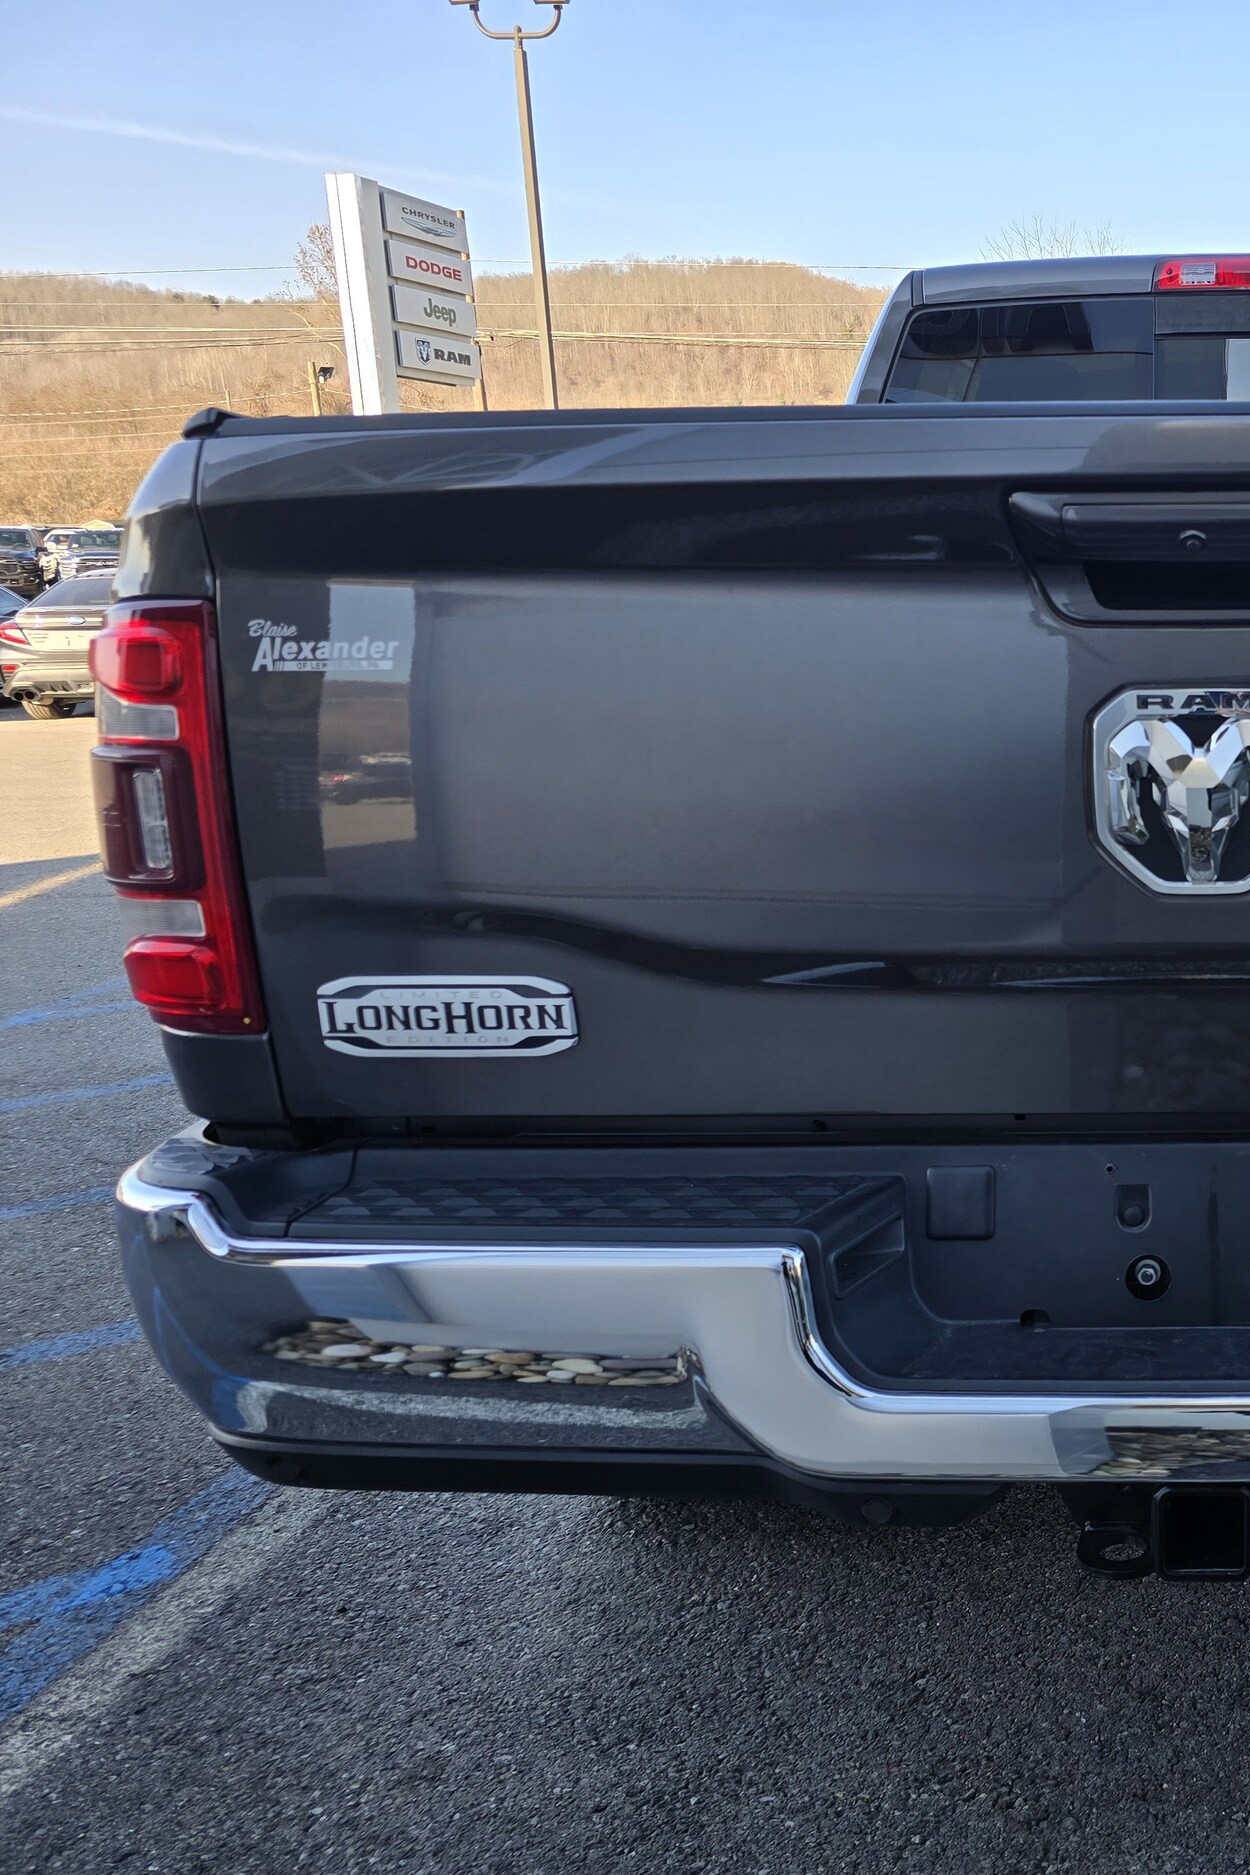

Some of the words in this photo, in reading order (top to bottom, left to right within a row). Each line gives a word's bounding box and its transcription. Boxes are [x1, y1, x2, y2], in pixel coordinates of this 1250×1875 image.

[401, 206, 456, 230] CHRYSLER
[405, 255, 463, 282] DODGE
[423, 297, 457, 327] Jeep
[433, 347, 472, 366] RAM
[248, 619, 297, 637] Blaise
[251, 636, 400, 672] Alexander
[296, 661, 308, 670] OF
[379, 990, 504, 1000] LIMITED
[385, 1035, 510, 1044] EDITION
